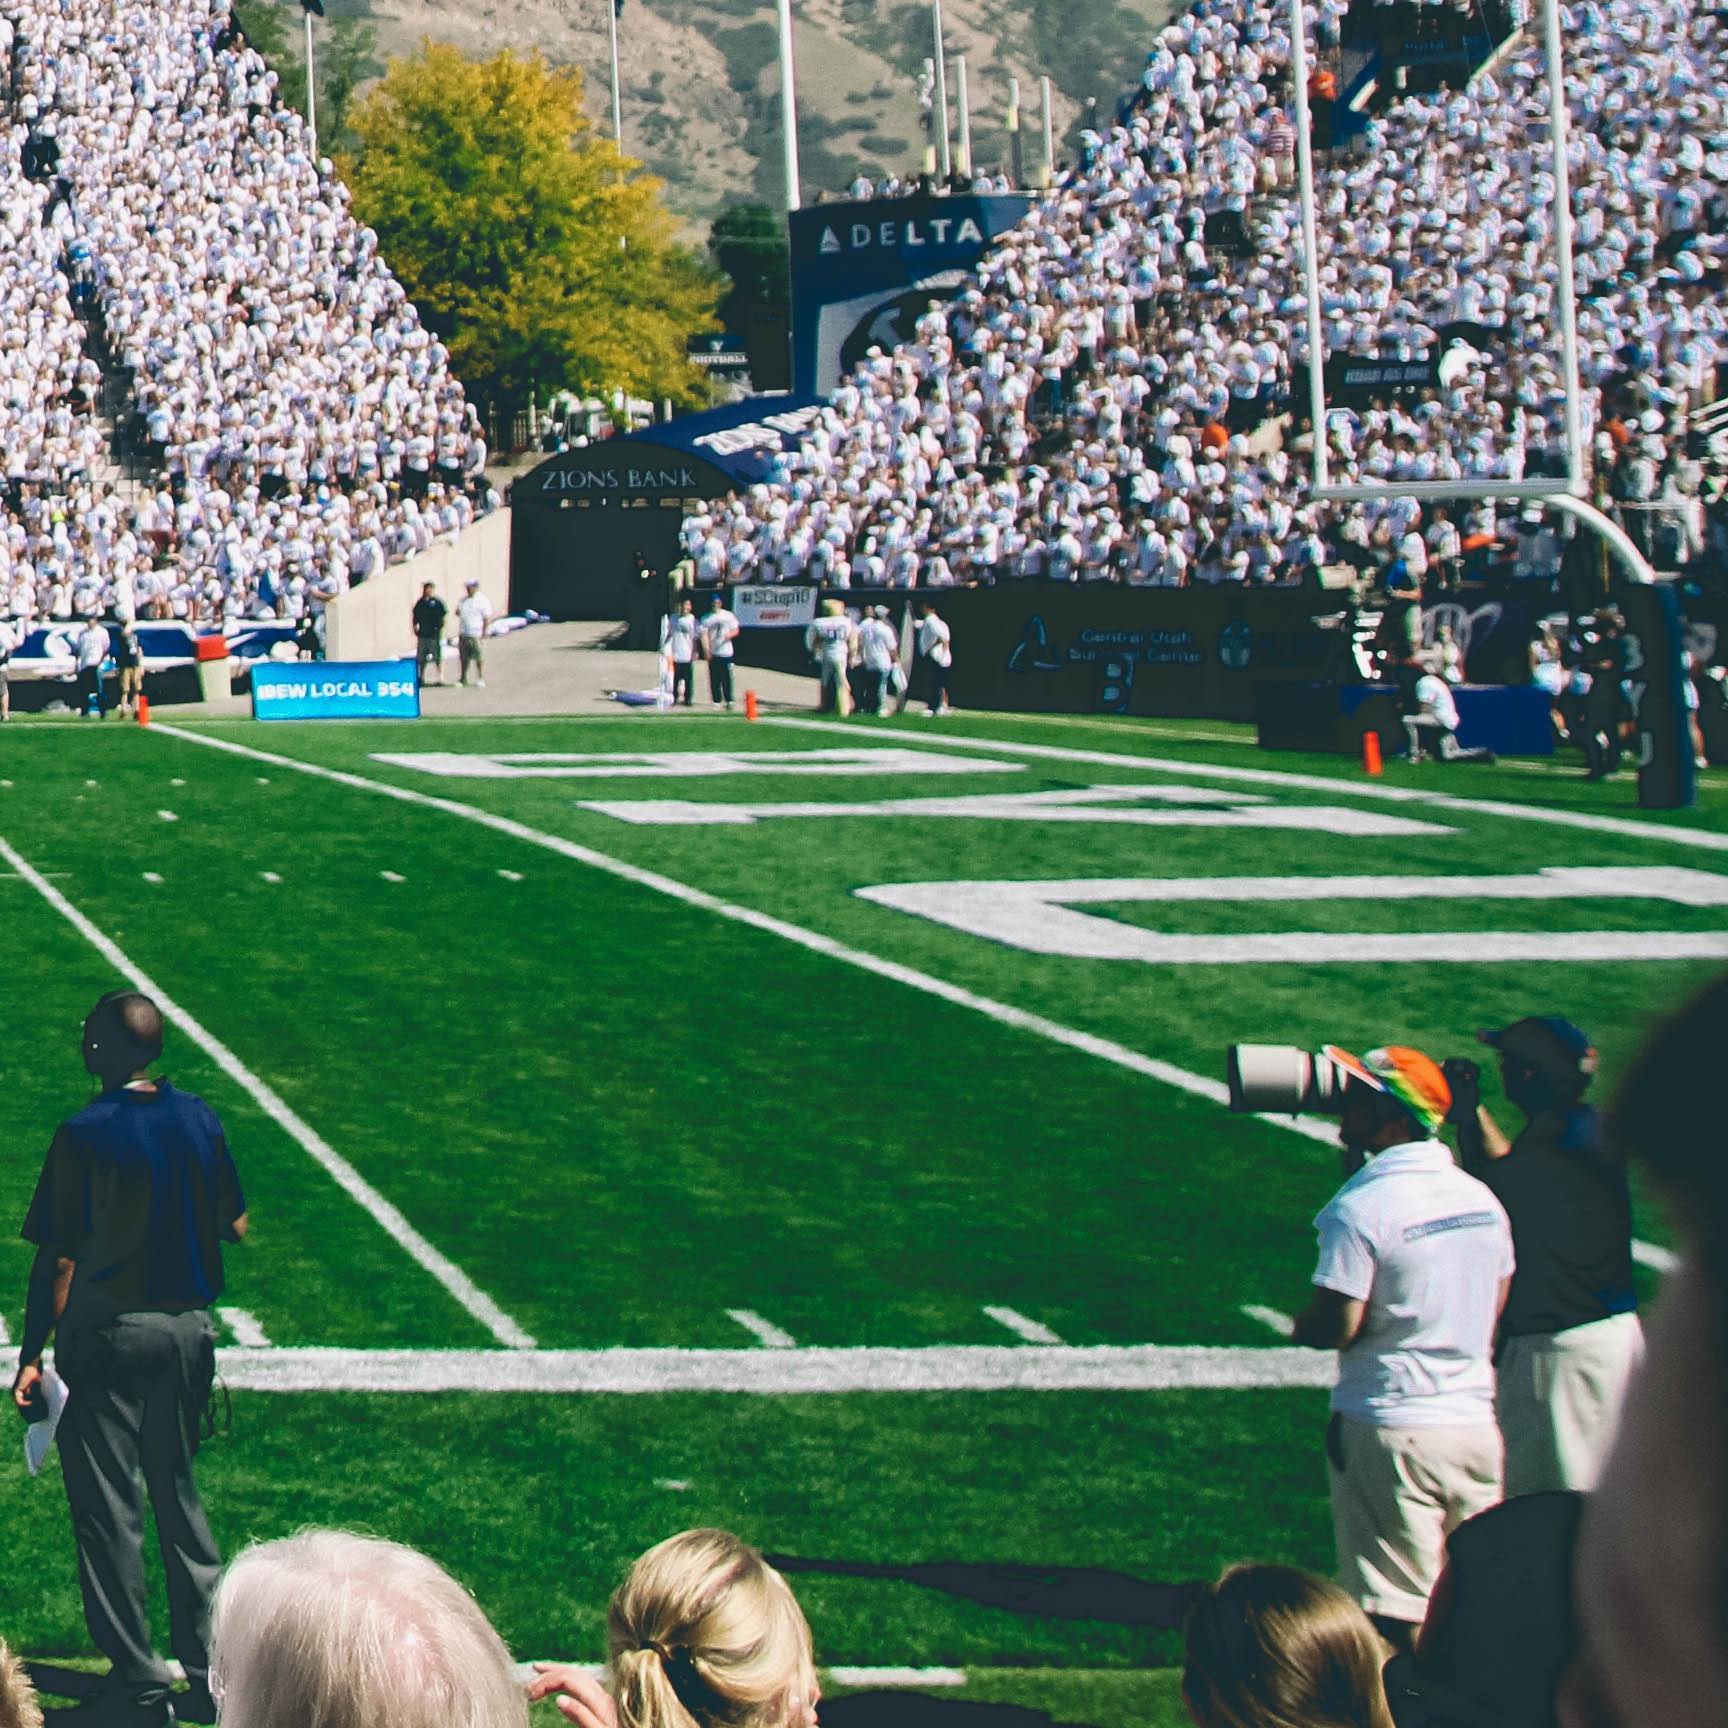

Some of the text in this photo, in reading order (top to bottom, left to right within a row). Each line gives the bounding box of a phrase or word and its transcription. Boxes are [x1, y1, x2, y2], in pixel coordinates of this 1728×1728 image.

[852, 218, 983, 248] DELTA
[543, 469, 696, 490] ZIONS BANK
[311, 682, 373, 698] LOCAL
[377, 681, 414, 697] 354
